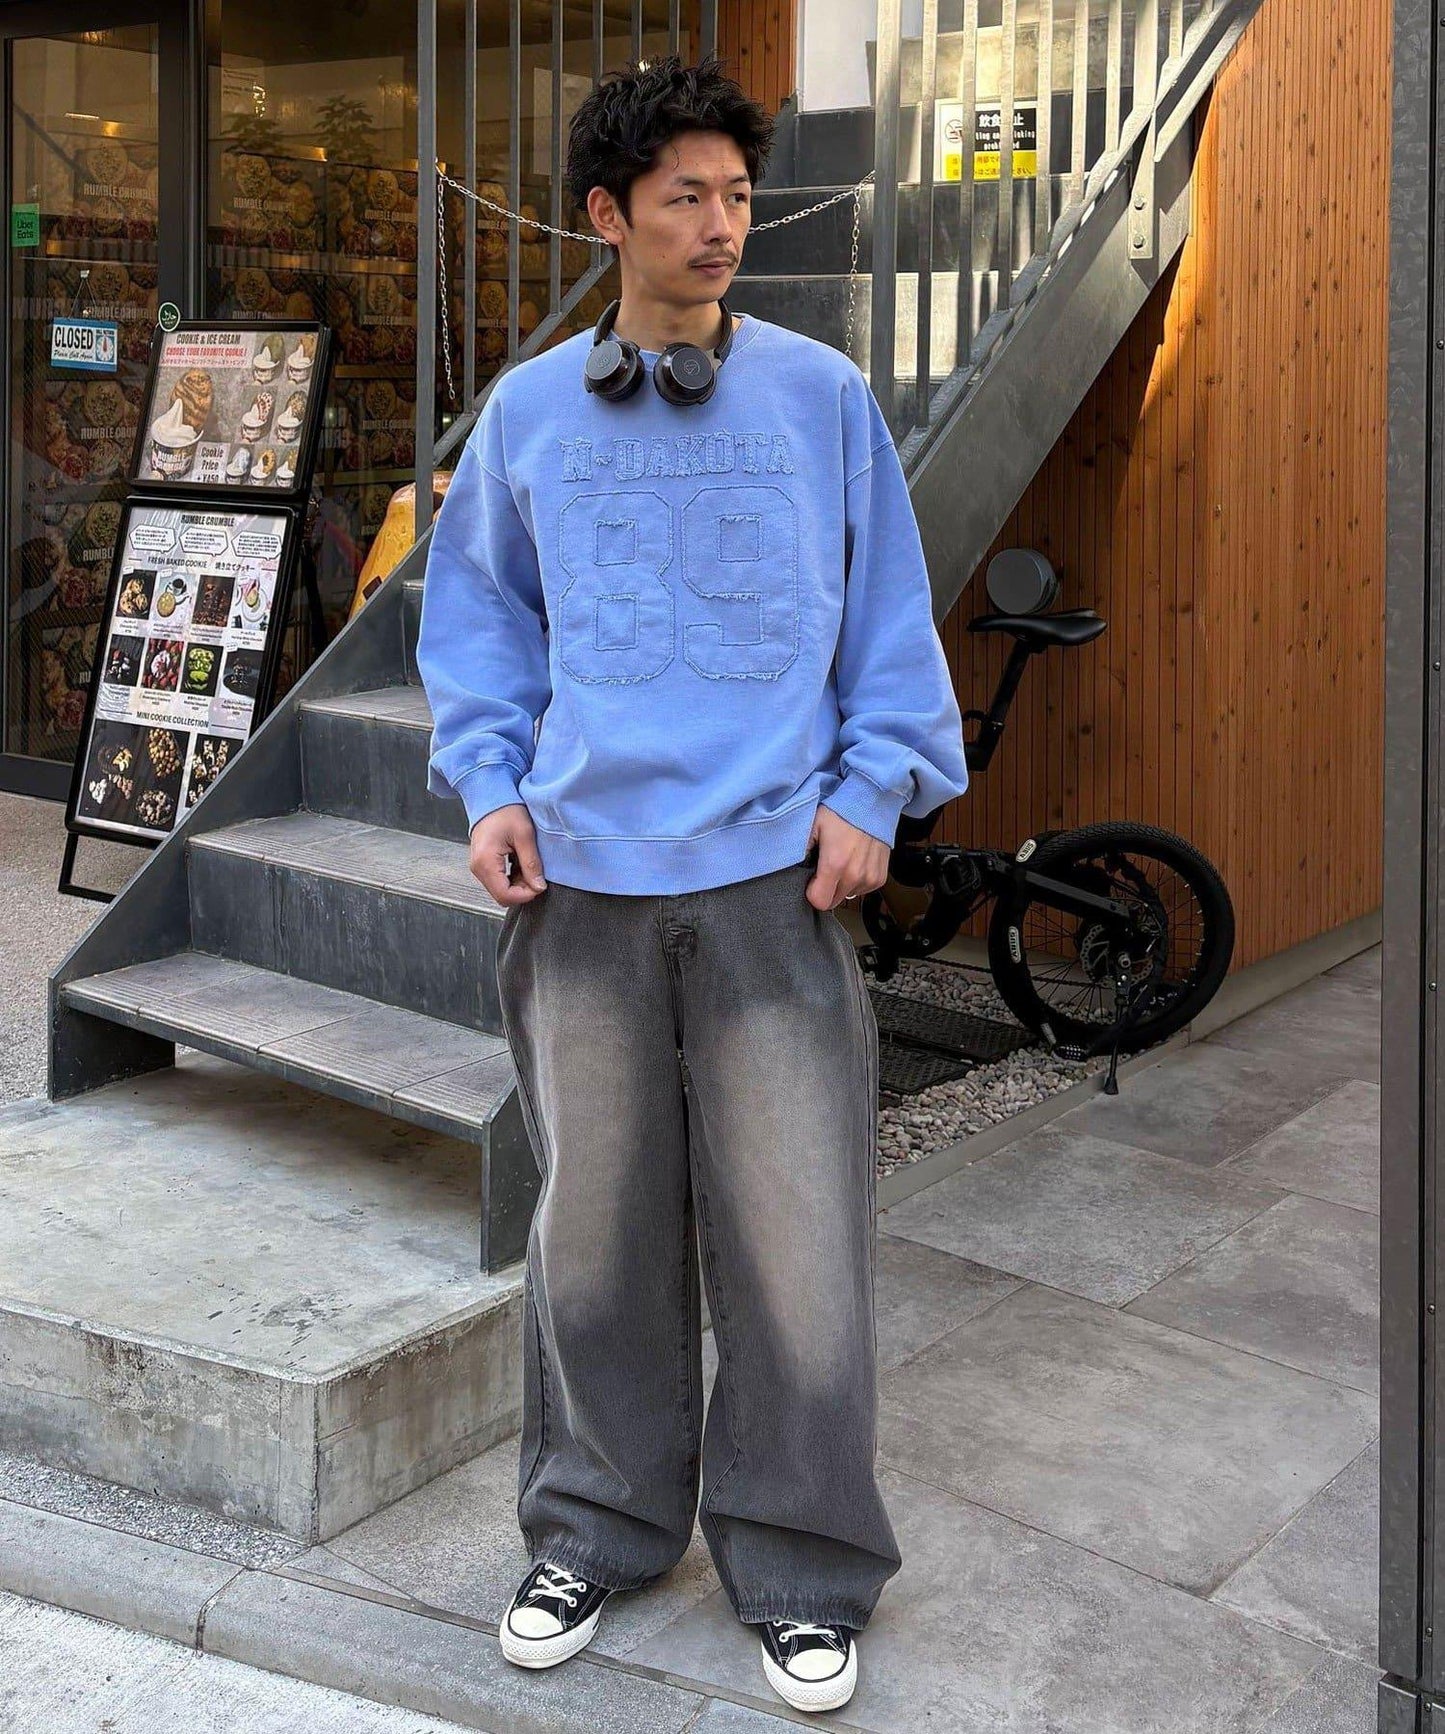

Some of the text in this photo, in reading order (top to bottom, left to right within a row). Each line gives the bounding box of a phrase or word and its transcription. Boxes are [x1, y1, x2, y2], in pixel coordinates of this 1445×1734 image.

[979, 112, 1024, 128] 飲食止
[17, 220, 34, 230] Uber
[17, 230, 34, 239] Eats
[55, 326, 94, 350] CLOSED
[176, 333, 241, 345] COOKIE & ICE CREAM
[166, 347, 186, 356] CHOOSE
[186, 347, 200, 356] YOUR
[200, 347, 224, 357] FAVORITE
[81, 426, 115, 440] RUMBLE
[201, 446, 224, 459] Cookie
[201, 460, 219, 471] Price
[181, 514, 235, 527] RUMBLE CRUMBLE
[148, 556, 208, 568] FRESH BAKED COOKIE
[558, 486, 800, 684] 89
[137, 711, 209, 728] MINI COOKIE COLLECTION
